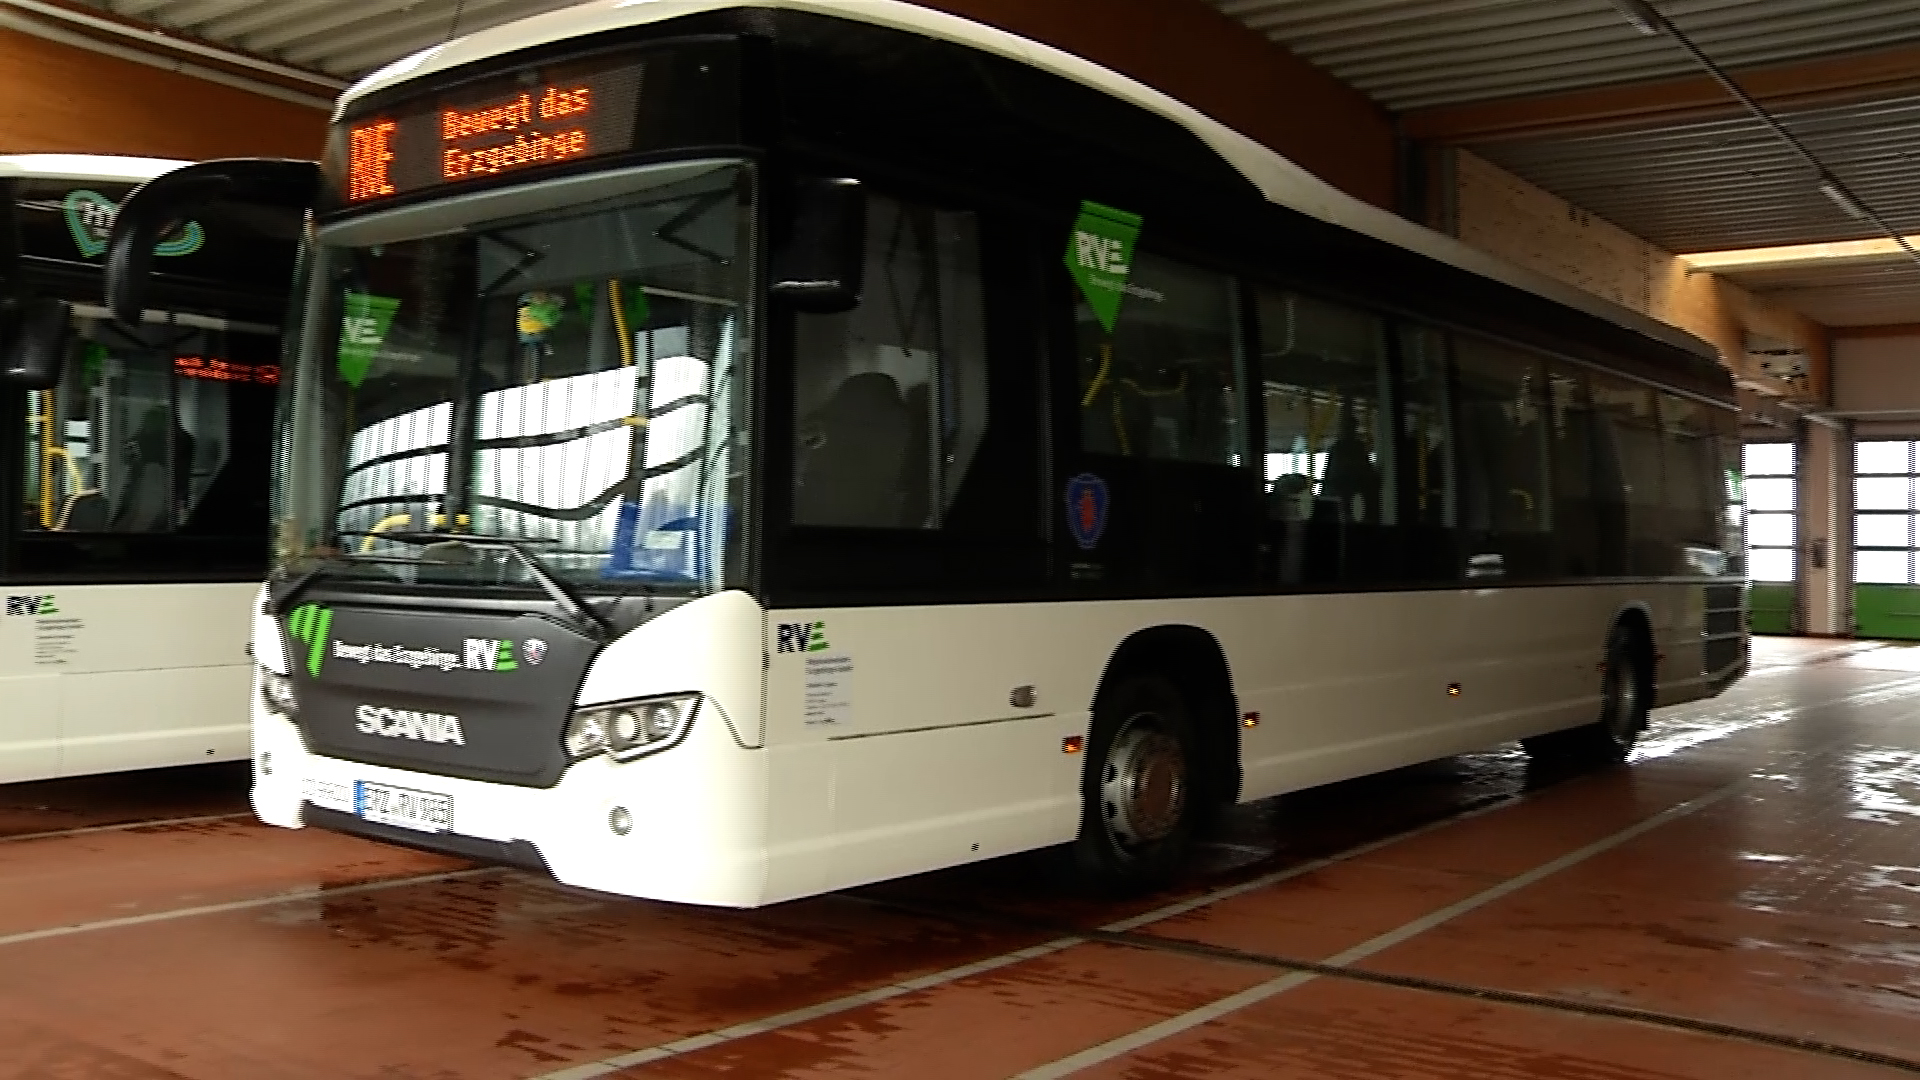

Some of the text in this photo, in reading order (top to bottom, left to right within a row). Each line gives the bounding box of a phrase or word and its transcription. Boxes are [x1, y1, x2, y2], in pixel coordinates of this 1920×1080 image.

[443, 87, 589, 140] Bewegt das
[443, 131, 587, 178] Erzgebirge
[332, 640, 373, 665] Bewegt
[371, 643, 394, 663] das
[463, 638, 519, 672] RVE
[777, 620, 830, 653] RVE
[354, 703, 466, 747] SCANIA
[363, 786, 390, 814] ERZ
[398, 793, 419, 819] RV
[420, 796, 449, 825] 985
